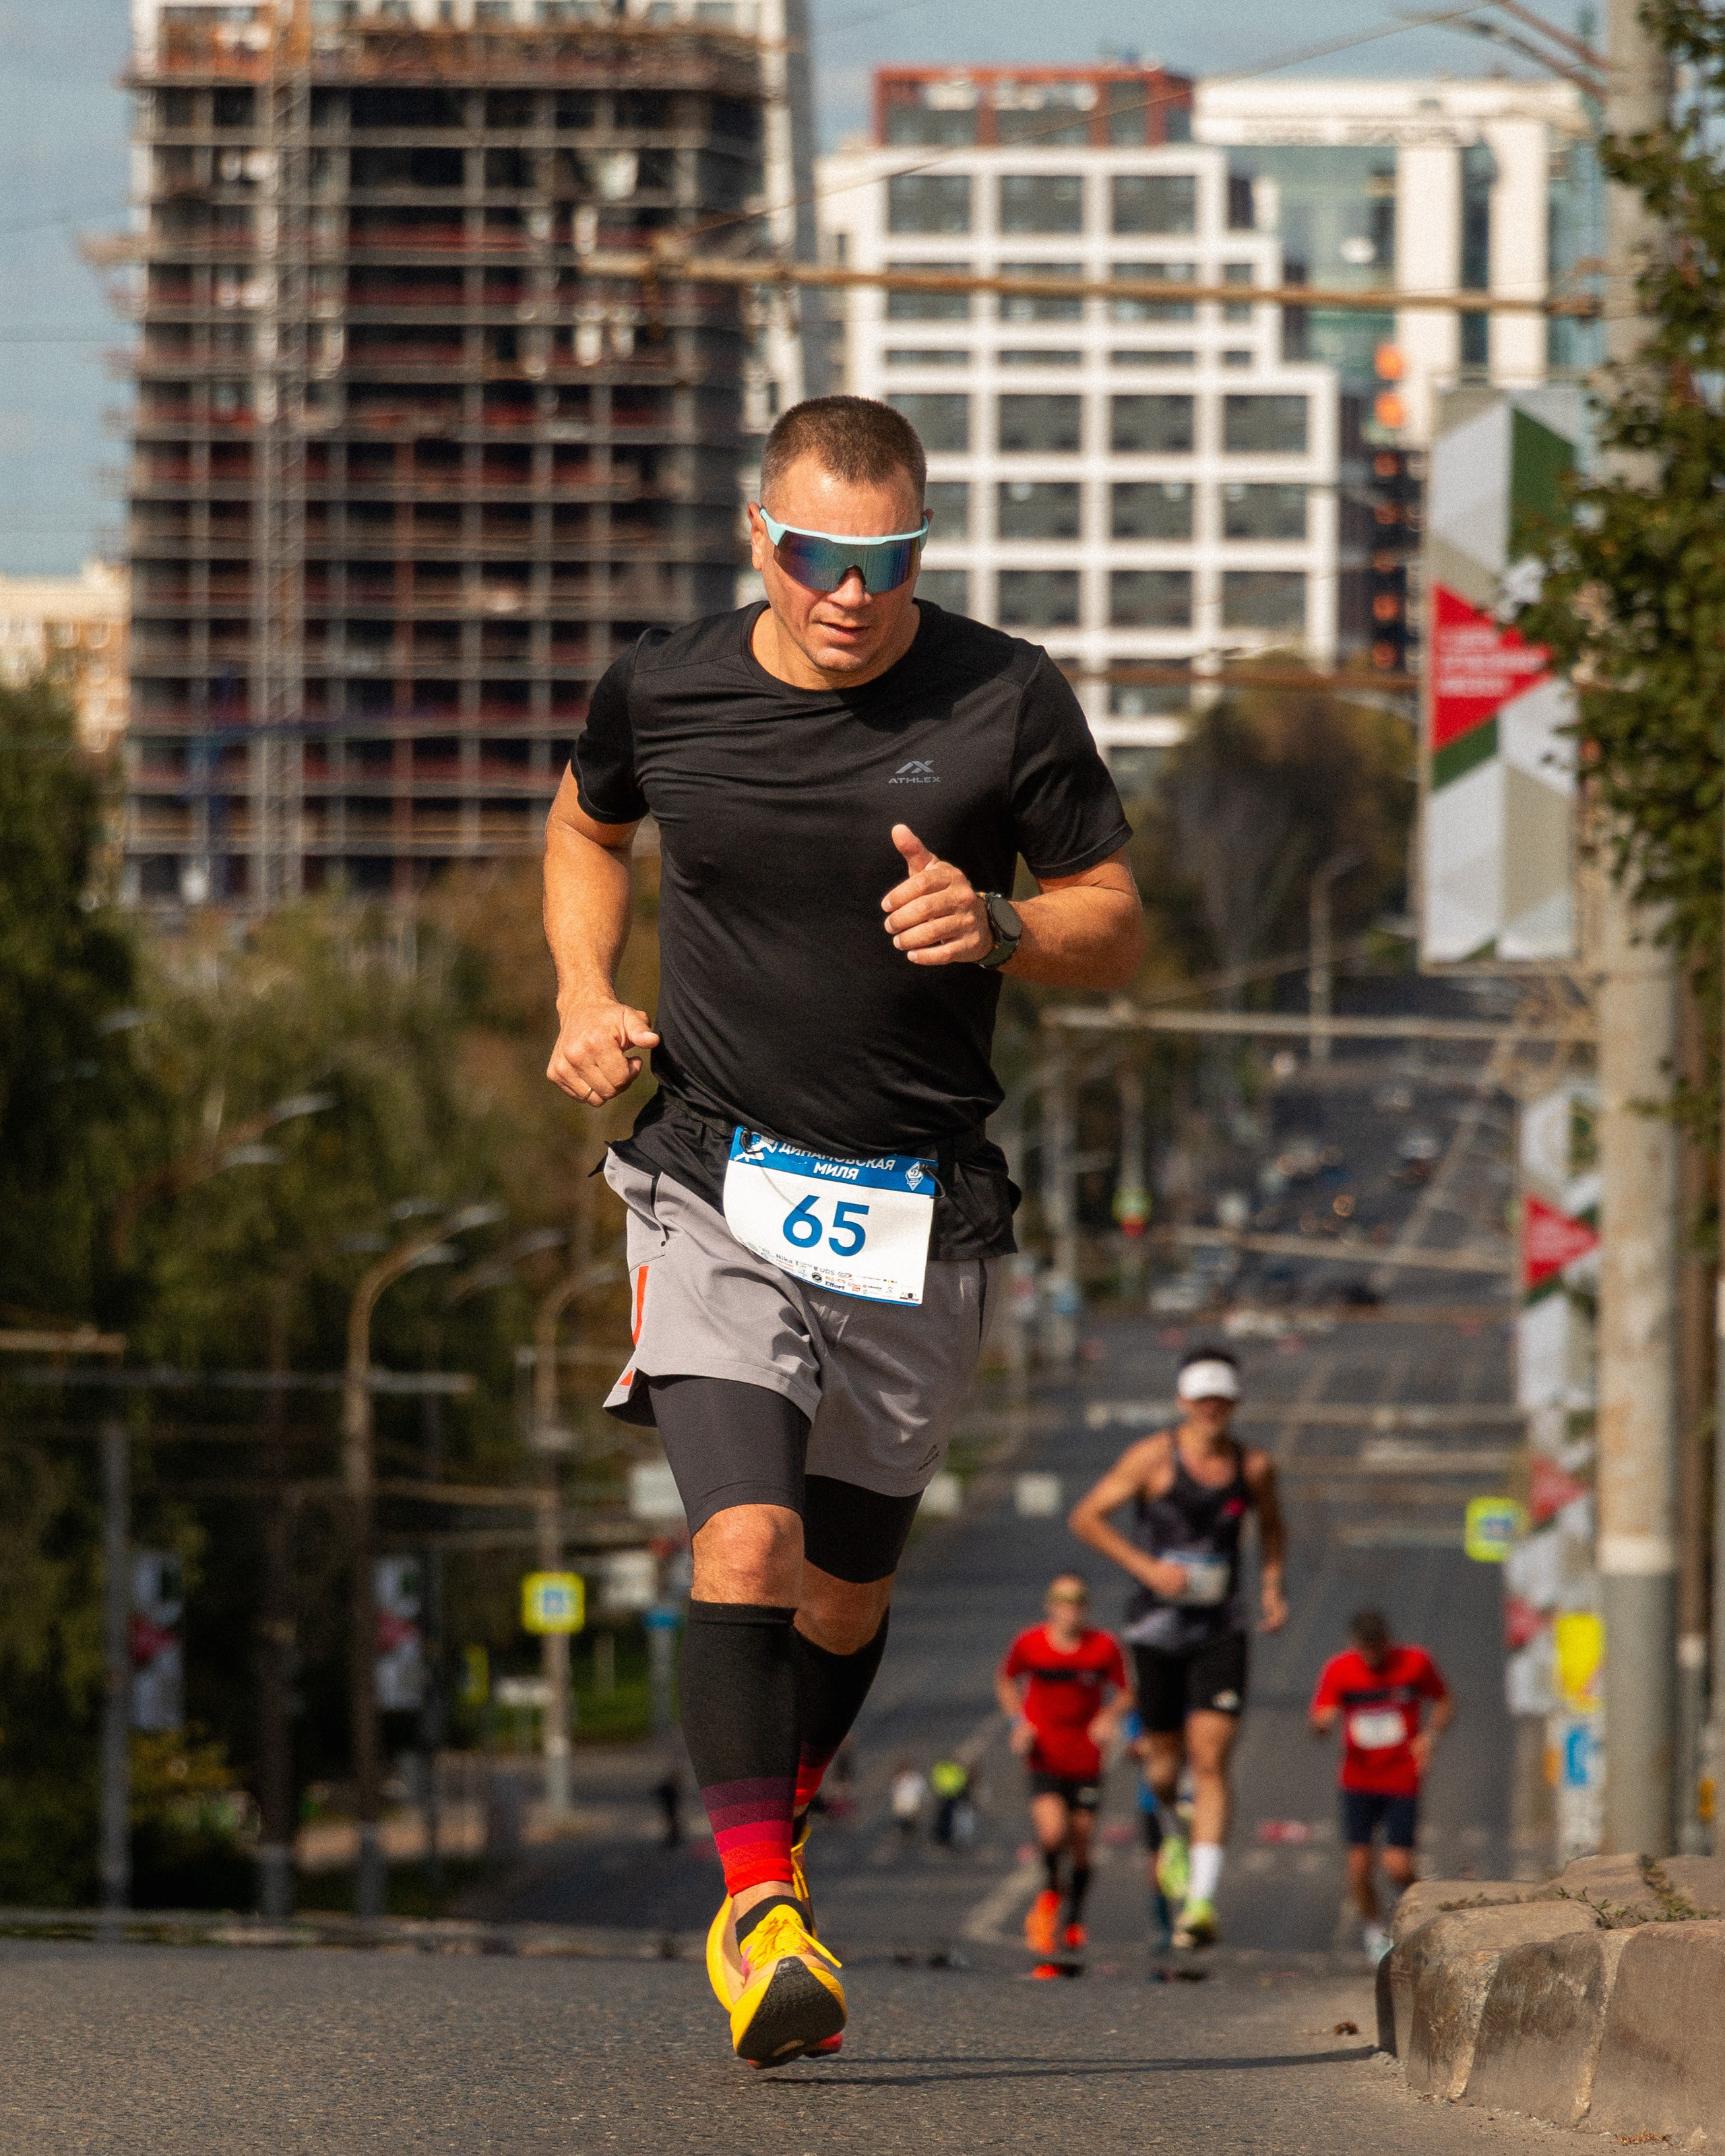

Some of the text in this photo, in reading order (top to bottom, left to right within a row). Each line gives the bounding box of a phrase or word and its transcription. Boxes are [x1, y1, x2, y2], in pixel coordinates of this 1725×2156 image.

[813, 1162, 860, 1180] МИЛЯ
[782, 1195, 870, 1257] 65
[820, 1267, 835, 1275] UDS
